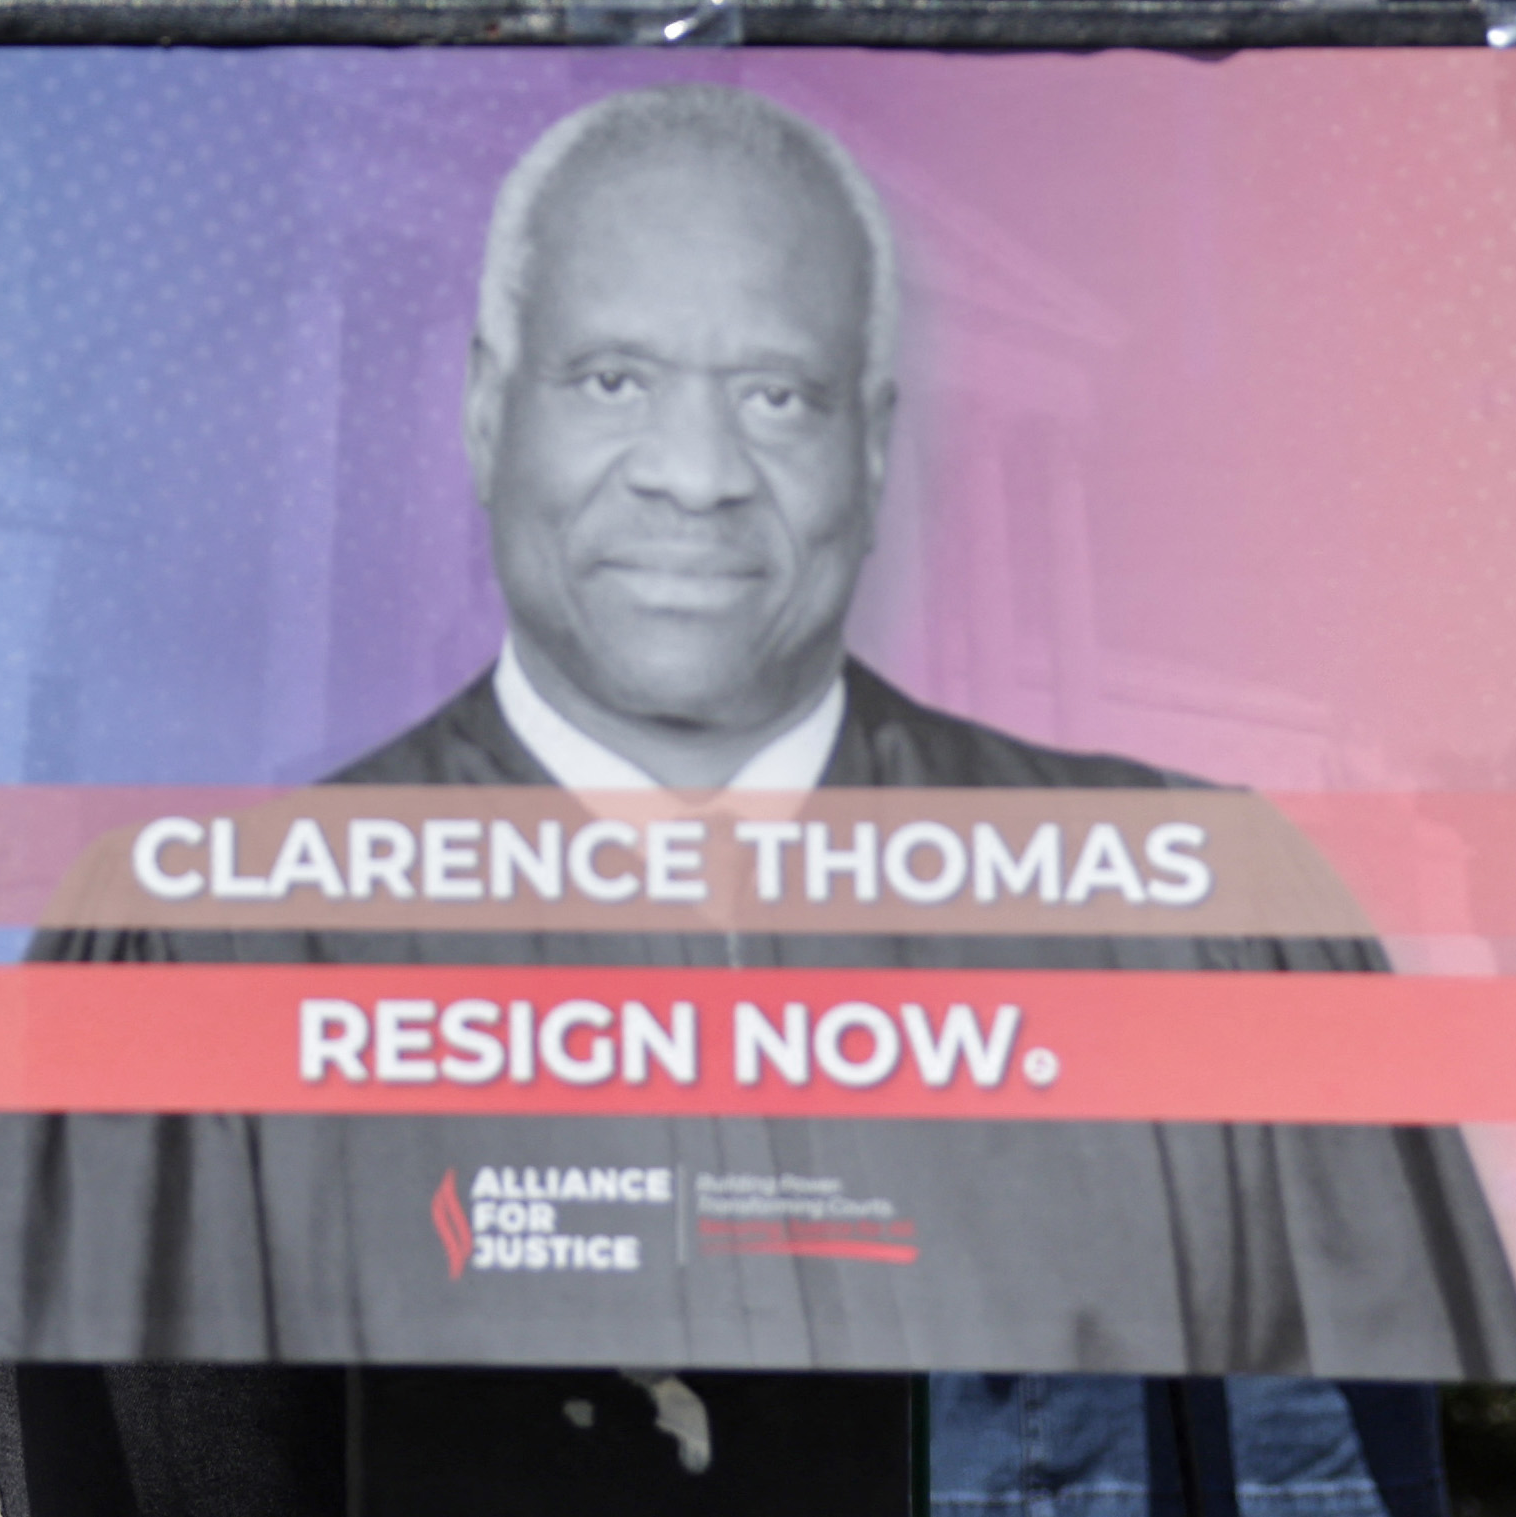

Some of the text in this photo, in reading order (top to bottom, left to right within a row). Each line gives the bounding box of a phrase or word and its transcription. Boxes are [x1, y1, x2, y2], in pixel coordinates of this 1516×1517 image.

[133, 818, 1212, 905] CLARENCE THOMAS
[300, 1000, 1060, 1088] RESIGN NOW.
[471, 1166, 673, 1202] ALLIANCE
[471, 1201, 558, 1235] FOR
[471, 1236, 641, 1271] JUSTICE
